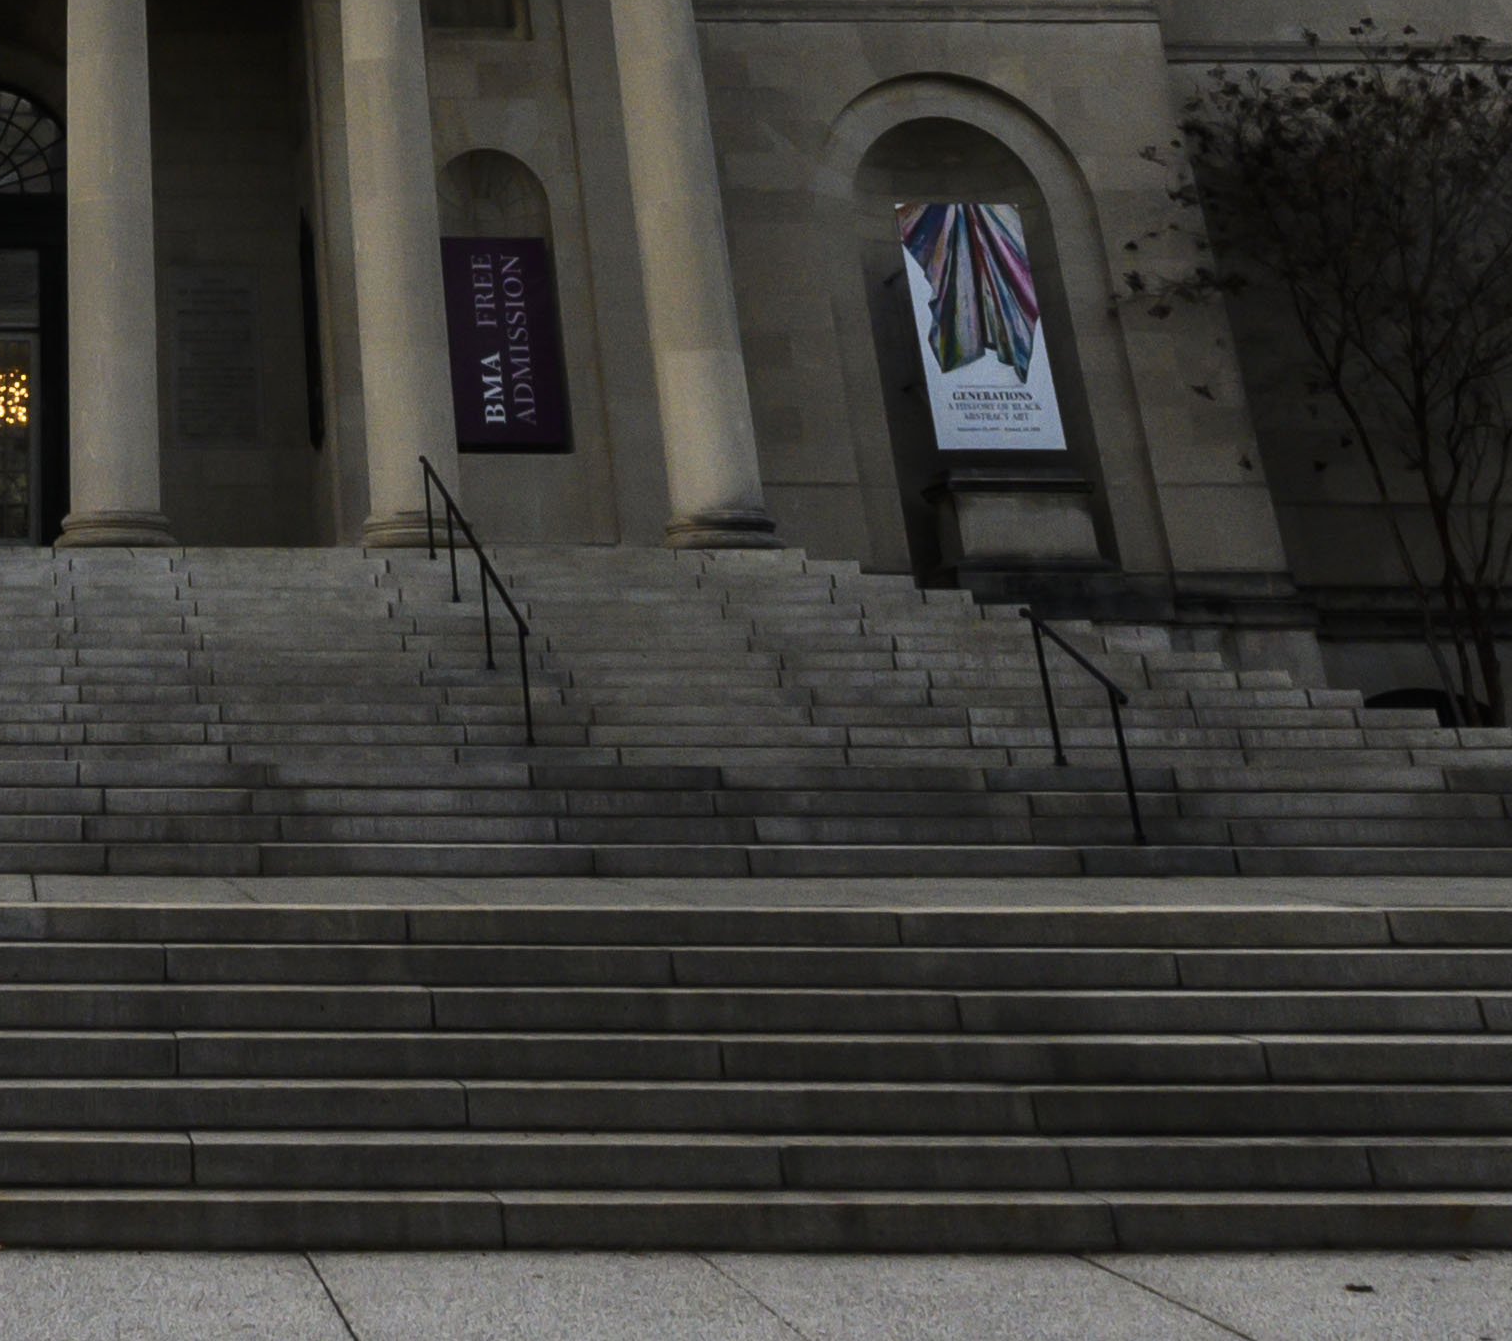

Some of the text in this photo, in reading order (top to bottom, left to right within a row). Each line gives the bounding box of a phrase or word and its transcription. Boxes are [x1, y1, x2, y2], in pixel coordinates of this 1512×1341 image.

[470, 253, 506, 424] BMA FREE
[500, 254, 537, 426] ADMISSION
[952, 391, 1033, 401] GENERATIONS
